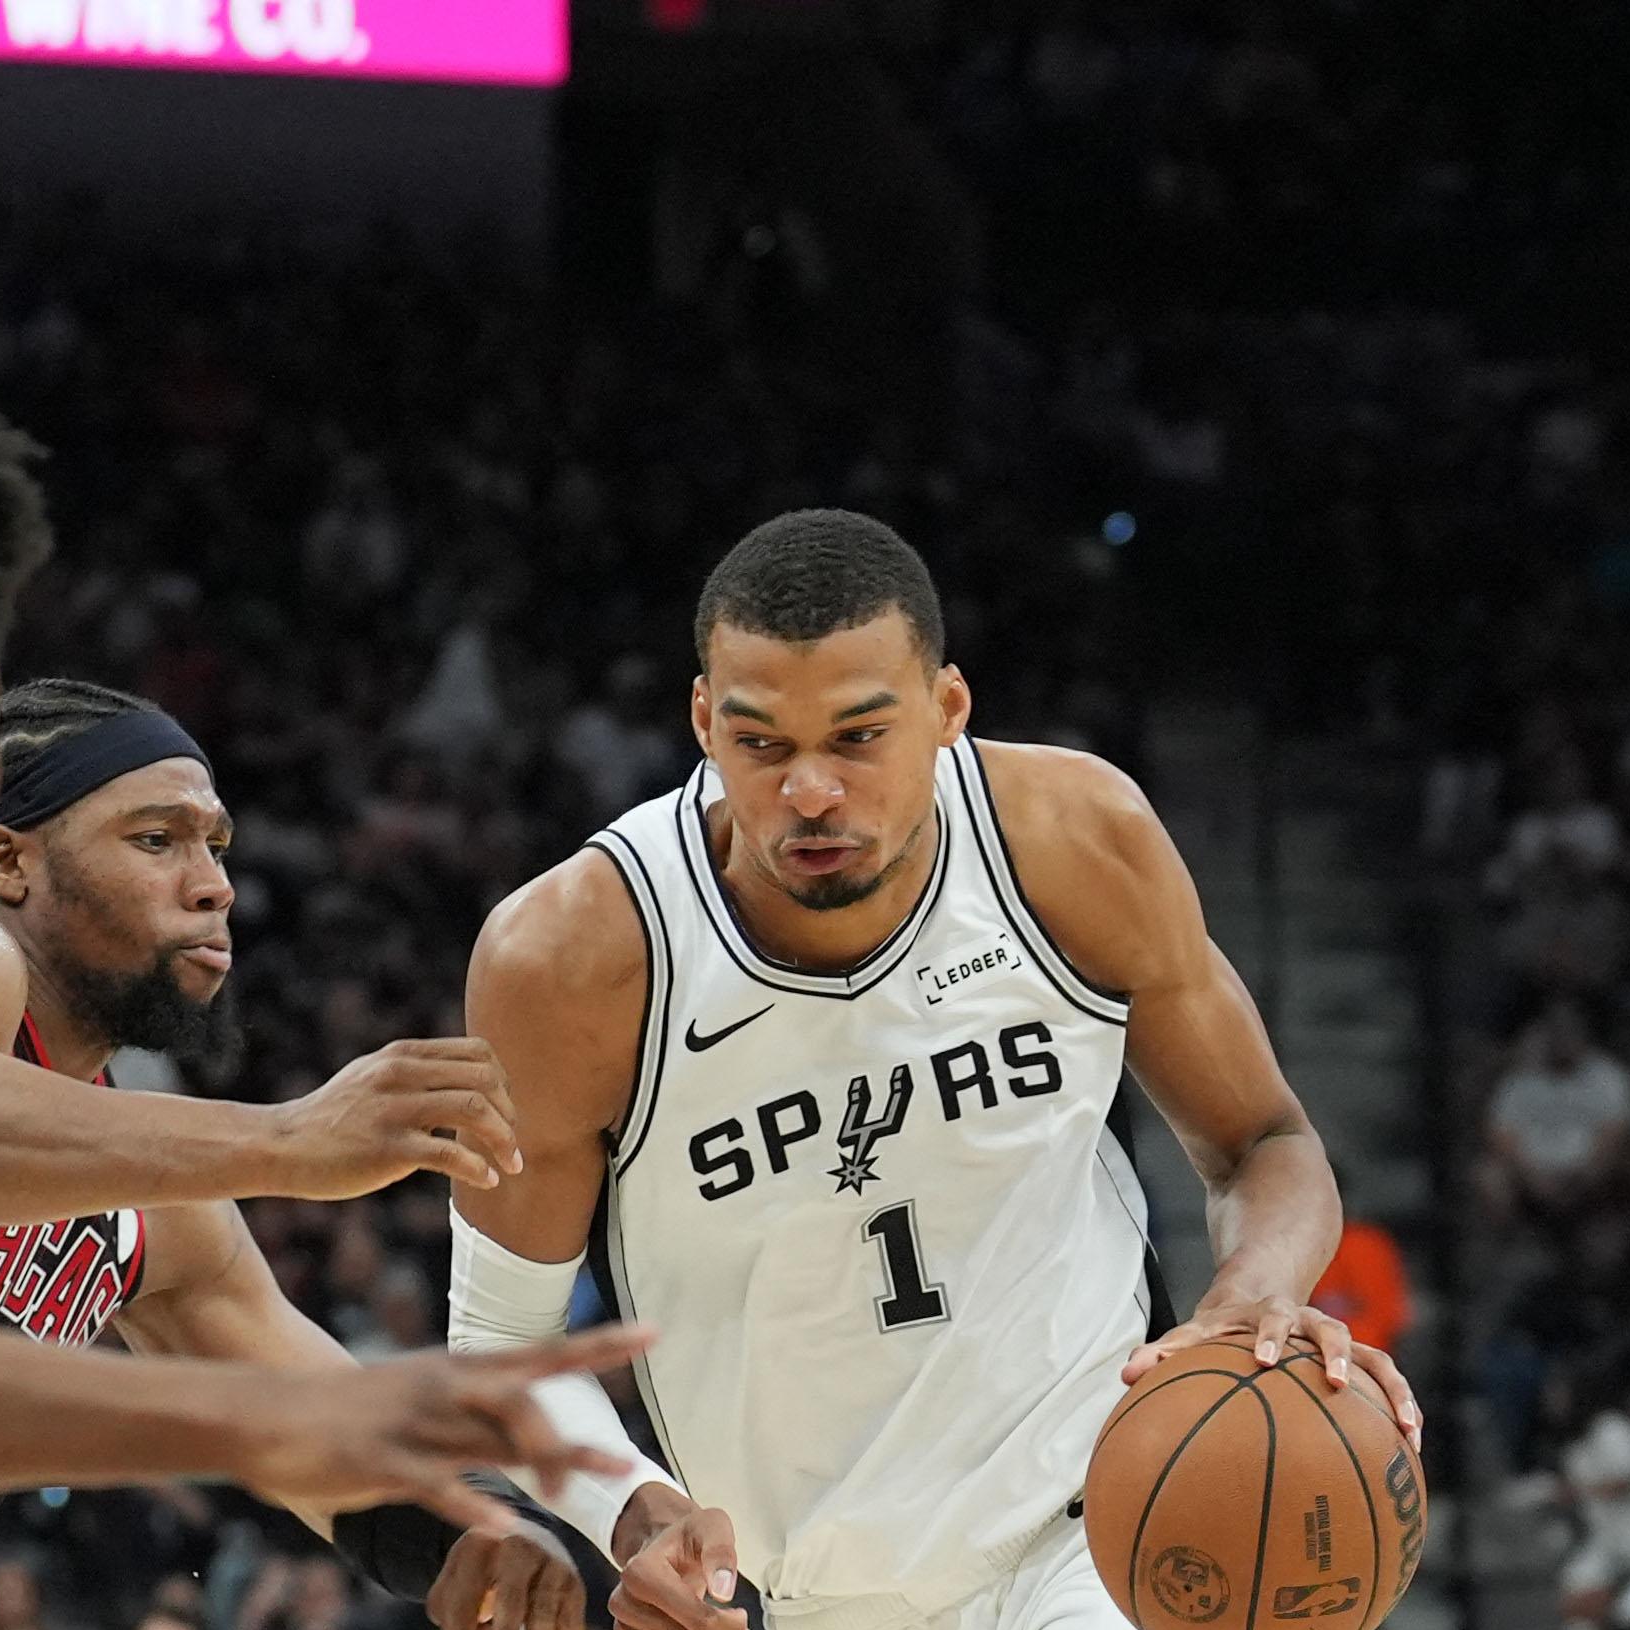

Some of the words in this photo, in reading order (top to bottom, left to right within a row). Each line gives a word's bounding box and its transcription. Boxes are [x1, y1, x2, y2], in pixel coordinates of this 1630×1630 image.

[933, 947, 1009, 991] LEDGER
[688, 1020, 1064, 1202] SPURS
[860, 1198, 951, 1335] 1
